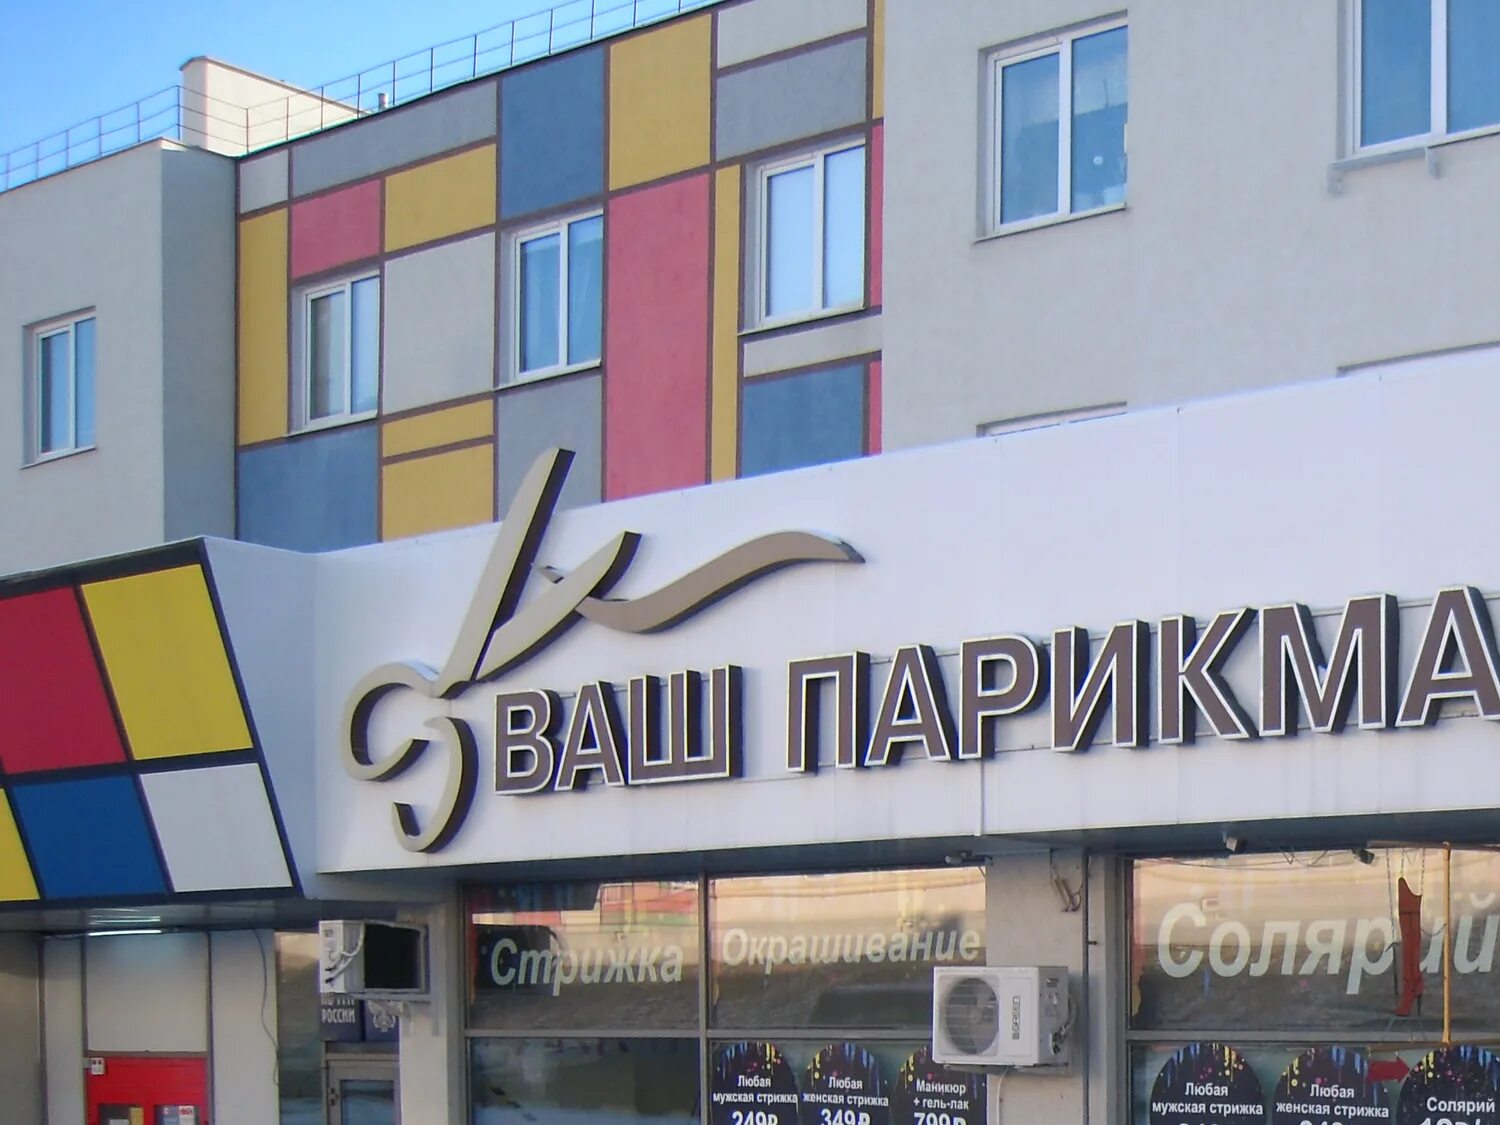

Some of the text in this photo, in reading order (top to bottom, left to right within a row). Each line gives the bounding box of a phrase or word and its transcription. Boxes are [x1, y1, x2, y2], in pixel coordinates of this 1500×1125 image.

[494, 664, 743, 797] ВАШ
[721, 927, 982, 974] Окрашивание
[491, 937, 684, 996] Стрижка
[738, 1075, 771, 1087] Любая
[828, 1076, 863, 1090] Любая
[916, 1078, 966, 1095] Маникюр
[1185, 1082, 1229, 1096] Любая
[1309, 1084, 1355, 1098] Любая
[713, 1093, 798, 1105] мужская стрижка
[802, 1093, 889, 1108] женская стрижка
[922, 1099, 969, 1111] гель-лак
[1426, 1096, 1496, 1116] Солярий
[1152, 1101, 1264, 1117] мужская стрижка
[1276, 1102, 1390, 1119] женская стрижка
